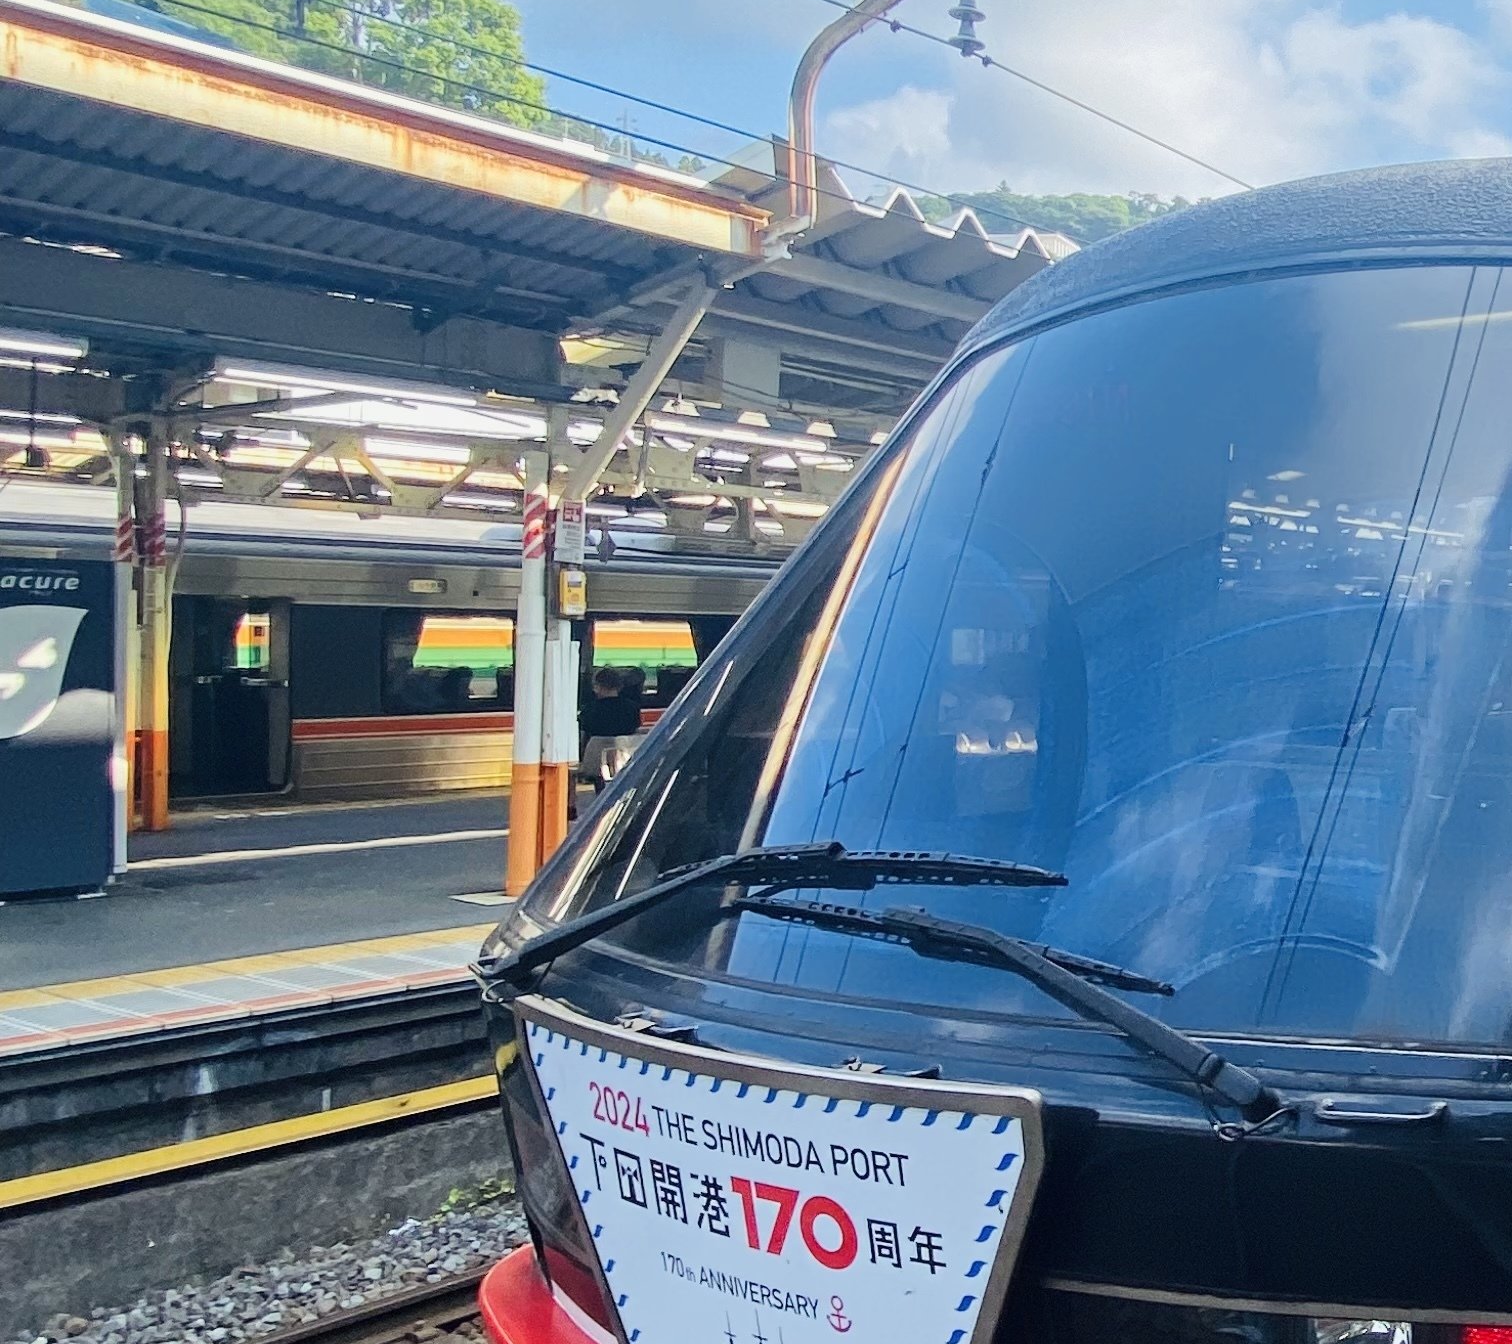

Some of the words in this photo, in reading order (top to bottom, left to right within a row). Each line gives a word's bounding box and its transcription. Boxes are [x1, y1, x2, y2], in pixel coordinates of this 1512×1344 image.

[0, 575, 80, 590] acure
[589, 1082, 650, 1137] 2024
[651, 1105, 698, 1146] THE
[702, 1119, 824, 1174] SHIMODA
[830, 1144, 909, 1187] PORT
[660, 1251, 697, 1283] 170th
[699, 1265, 819, 1320] ANNIVERSARY
